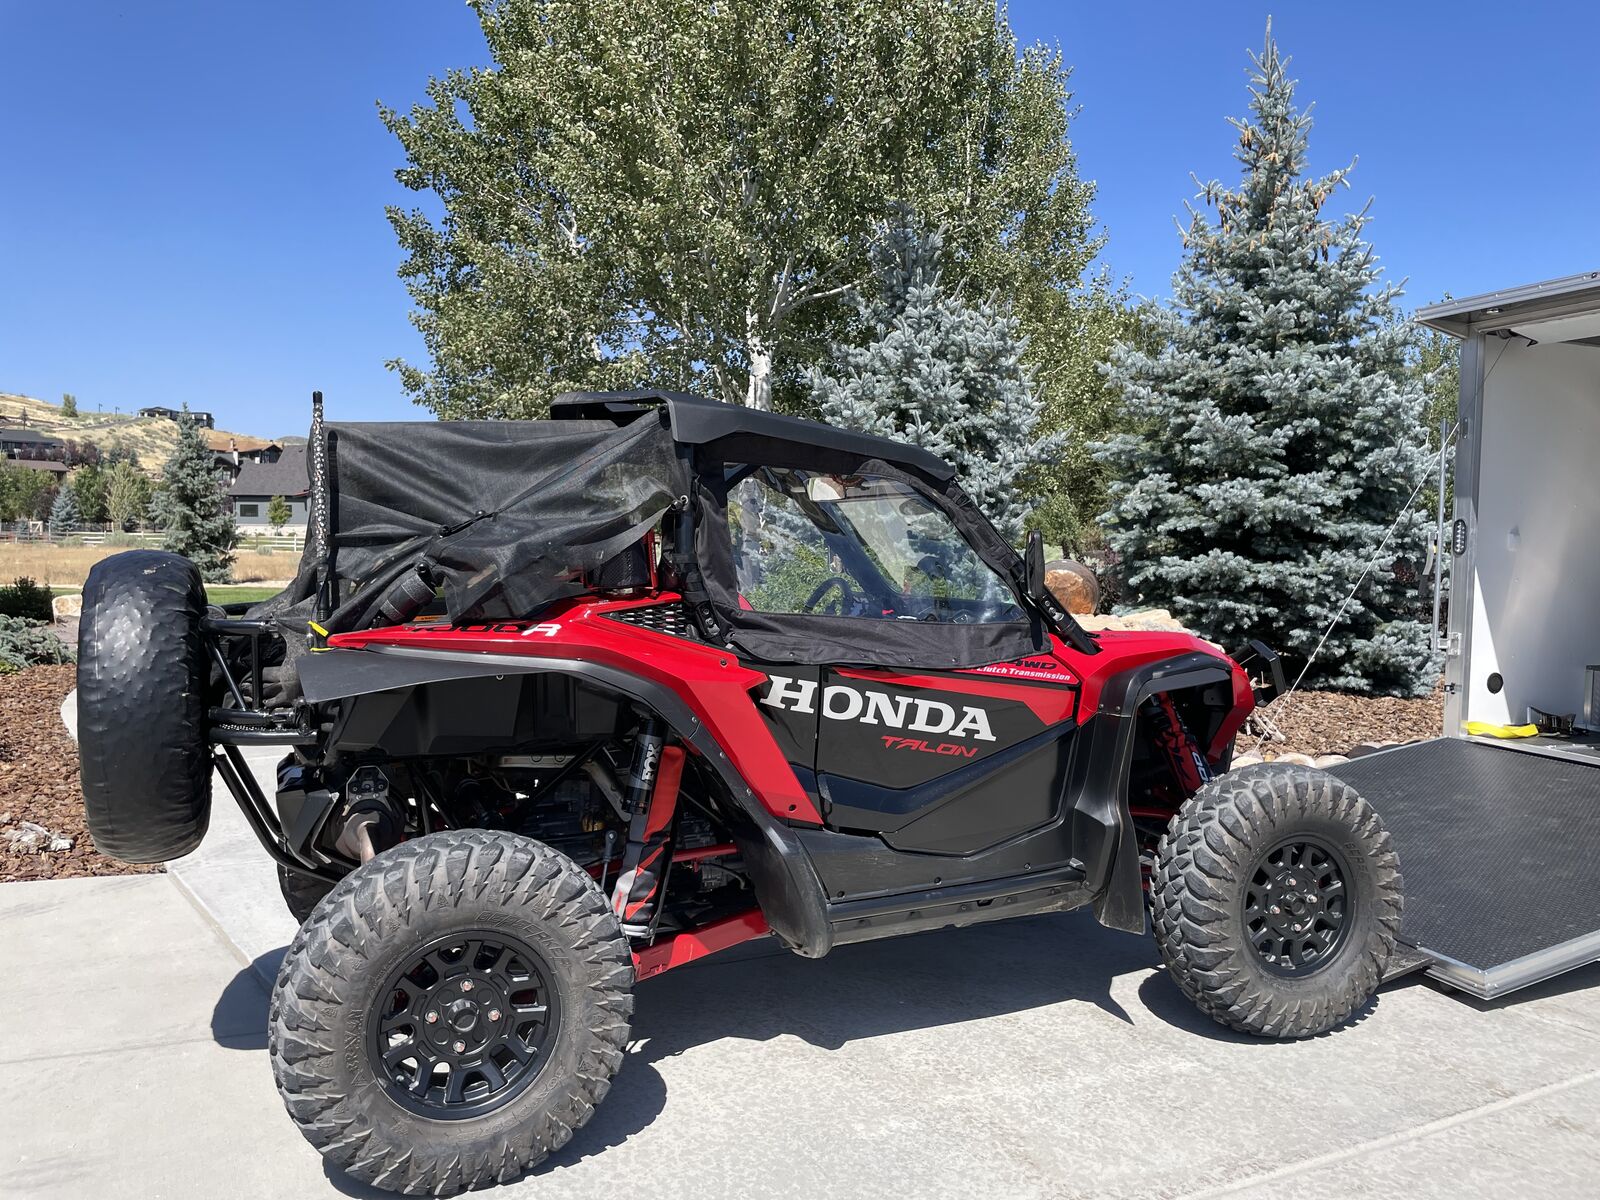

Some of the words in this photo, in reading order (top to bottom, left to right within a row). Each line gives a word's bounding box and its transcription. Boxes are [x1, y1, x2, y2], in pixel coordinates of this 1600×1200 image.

[1009, 668, 1071, 681] Transmission
[760, 674, 997, 742] HONDA
[880, 735, 979, 759] TALON
